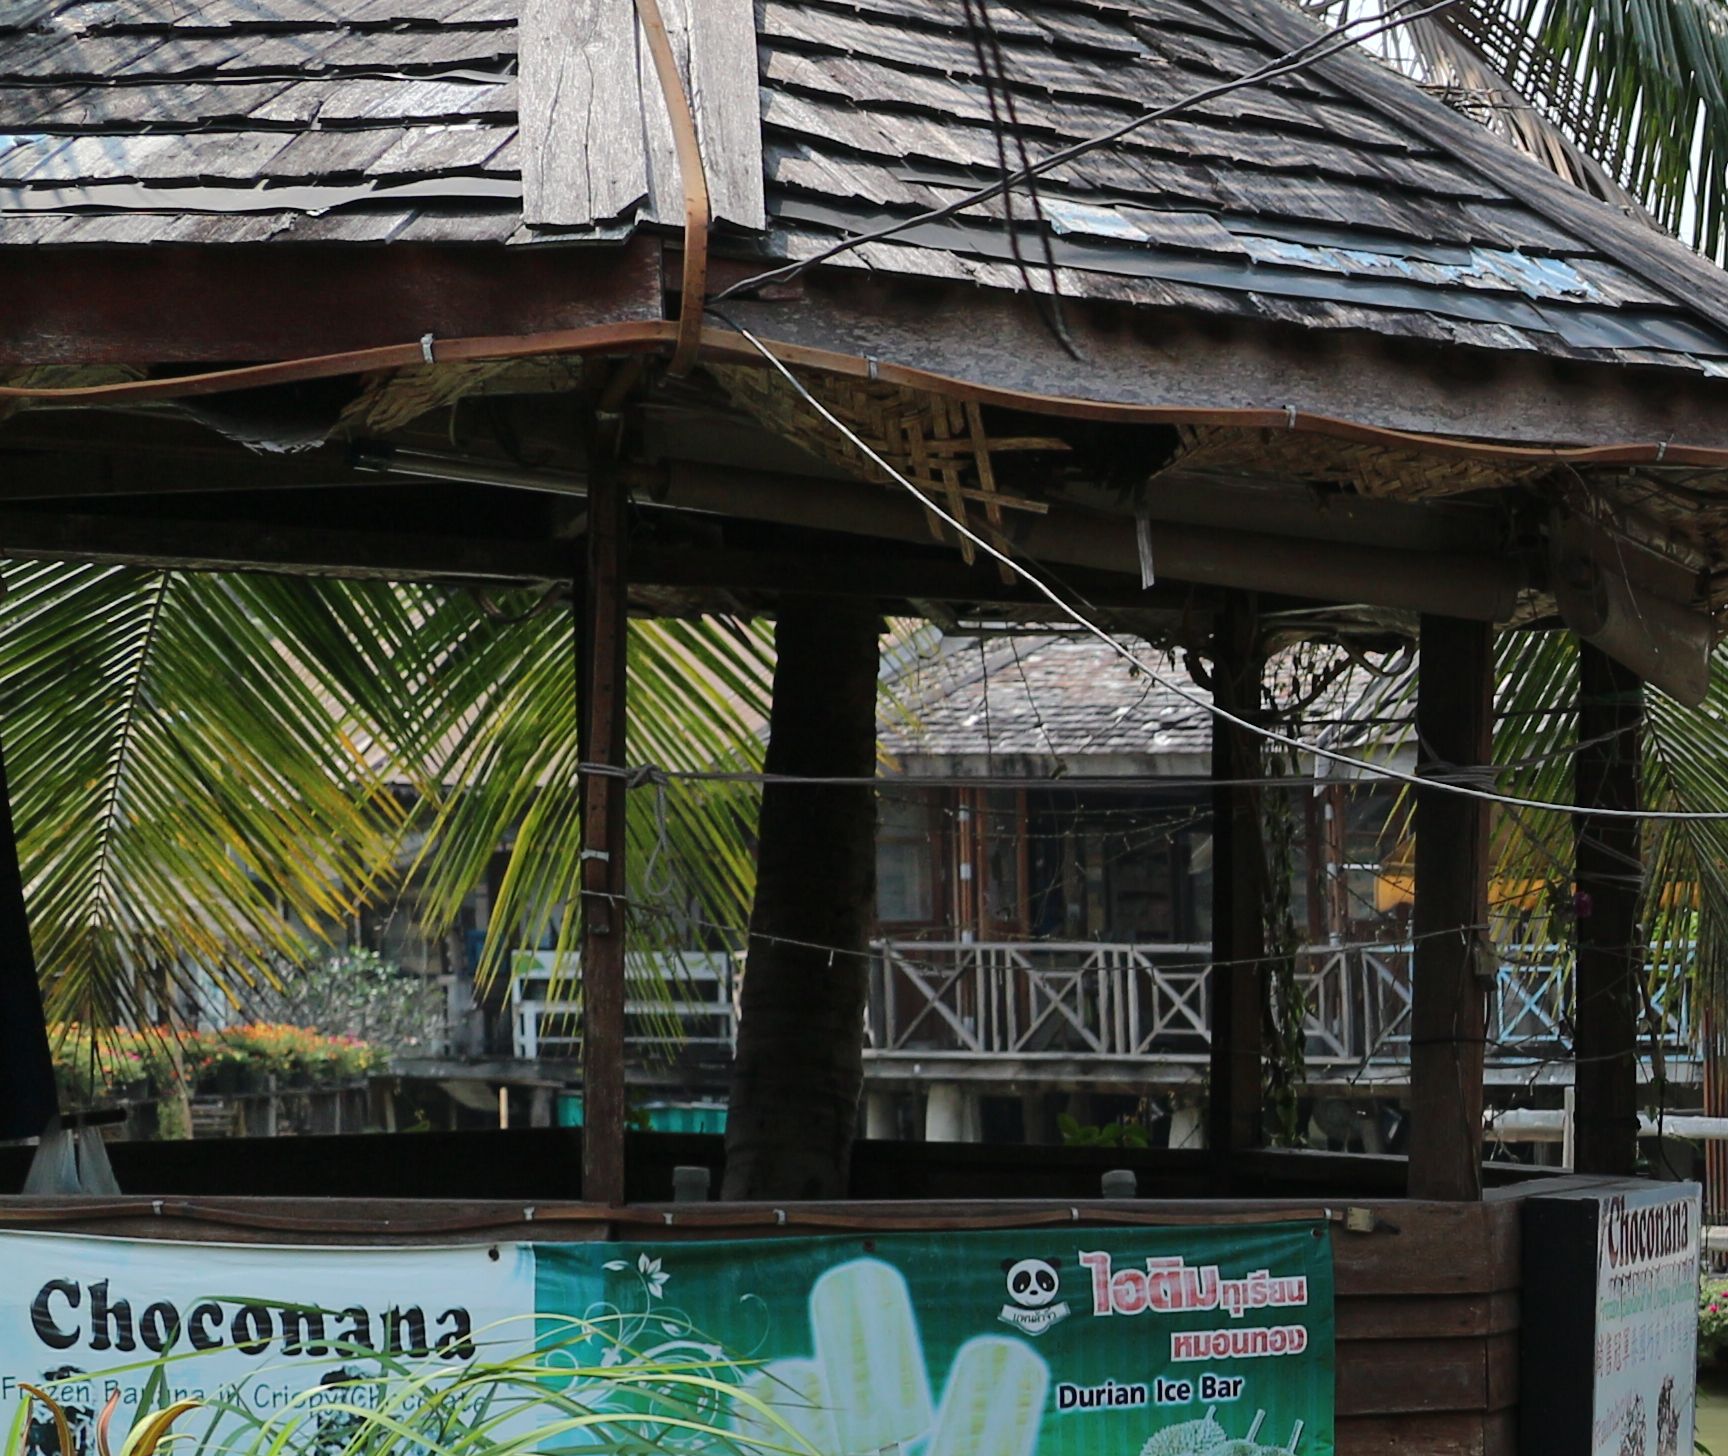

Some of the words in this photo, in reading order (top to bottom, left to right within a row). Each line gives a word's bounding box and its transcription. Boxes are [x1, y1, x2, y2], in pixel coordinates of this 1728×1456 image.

[1608, 1193, 1689, 1269] Choconana
[30, 1277, 476, 1361] Choconana
[1171, 1325, 1308, 1362] หมอนทอง
[1058, 1381, 1146, 1409] Durian
[1157, 1379, 1191, 1402] Ice
[1201, 1375, 1243, 1399] Bar
